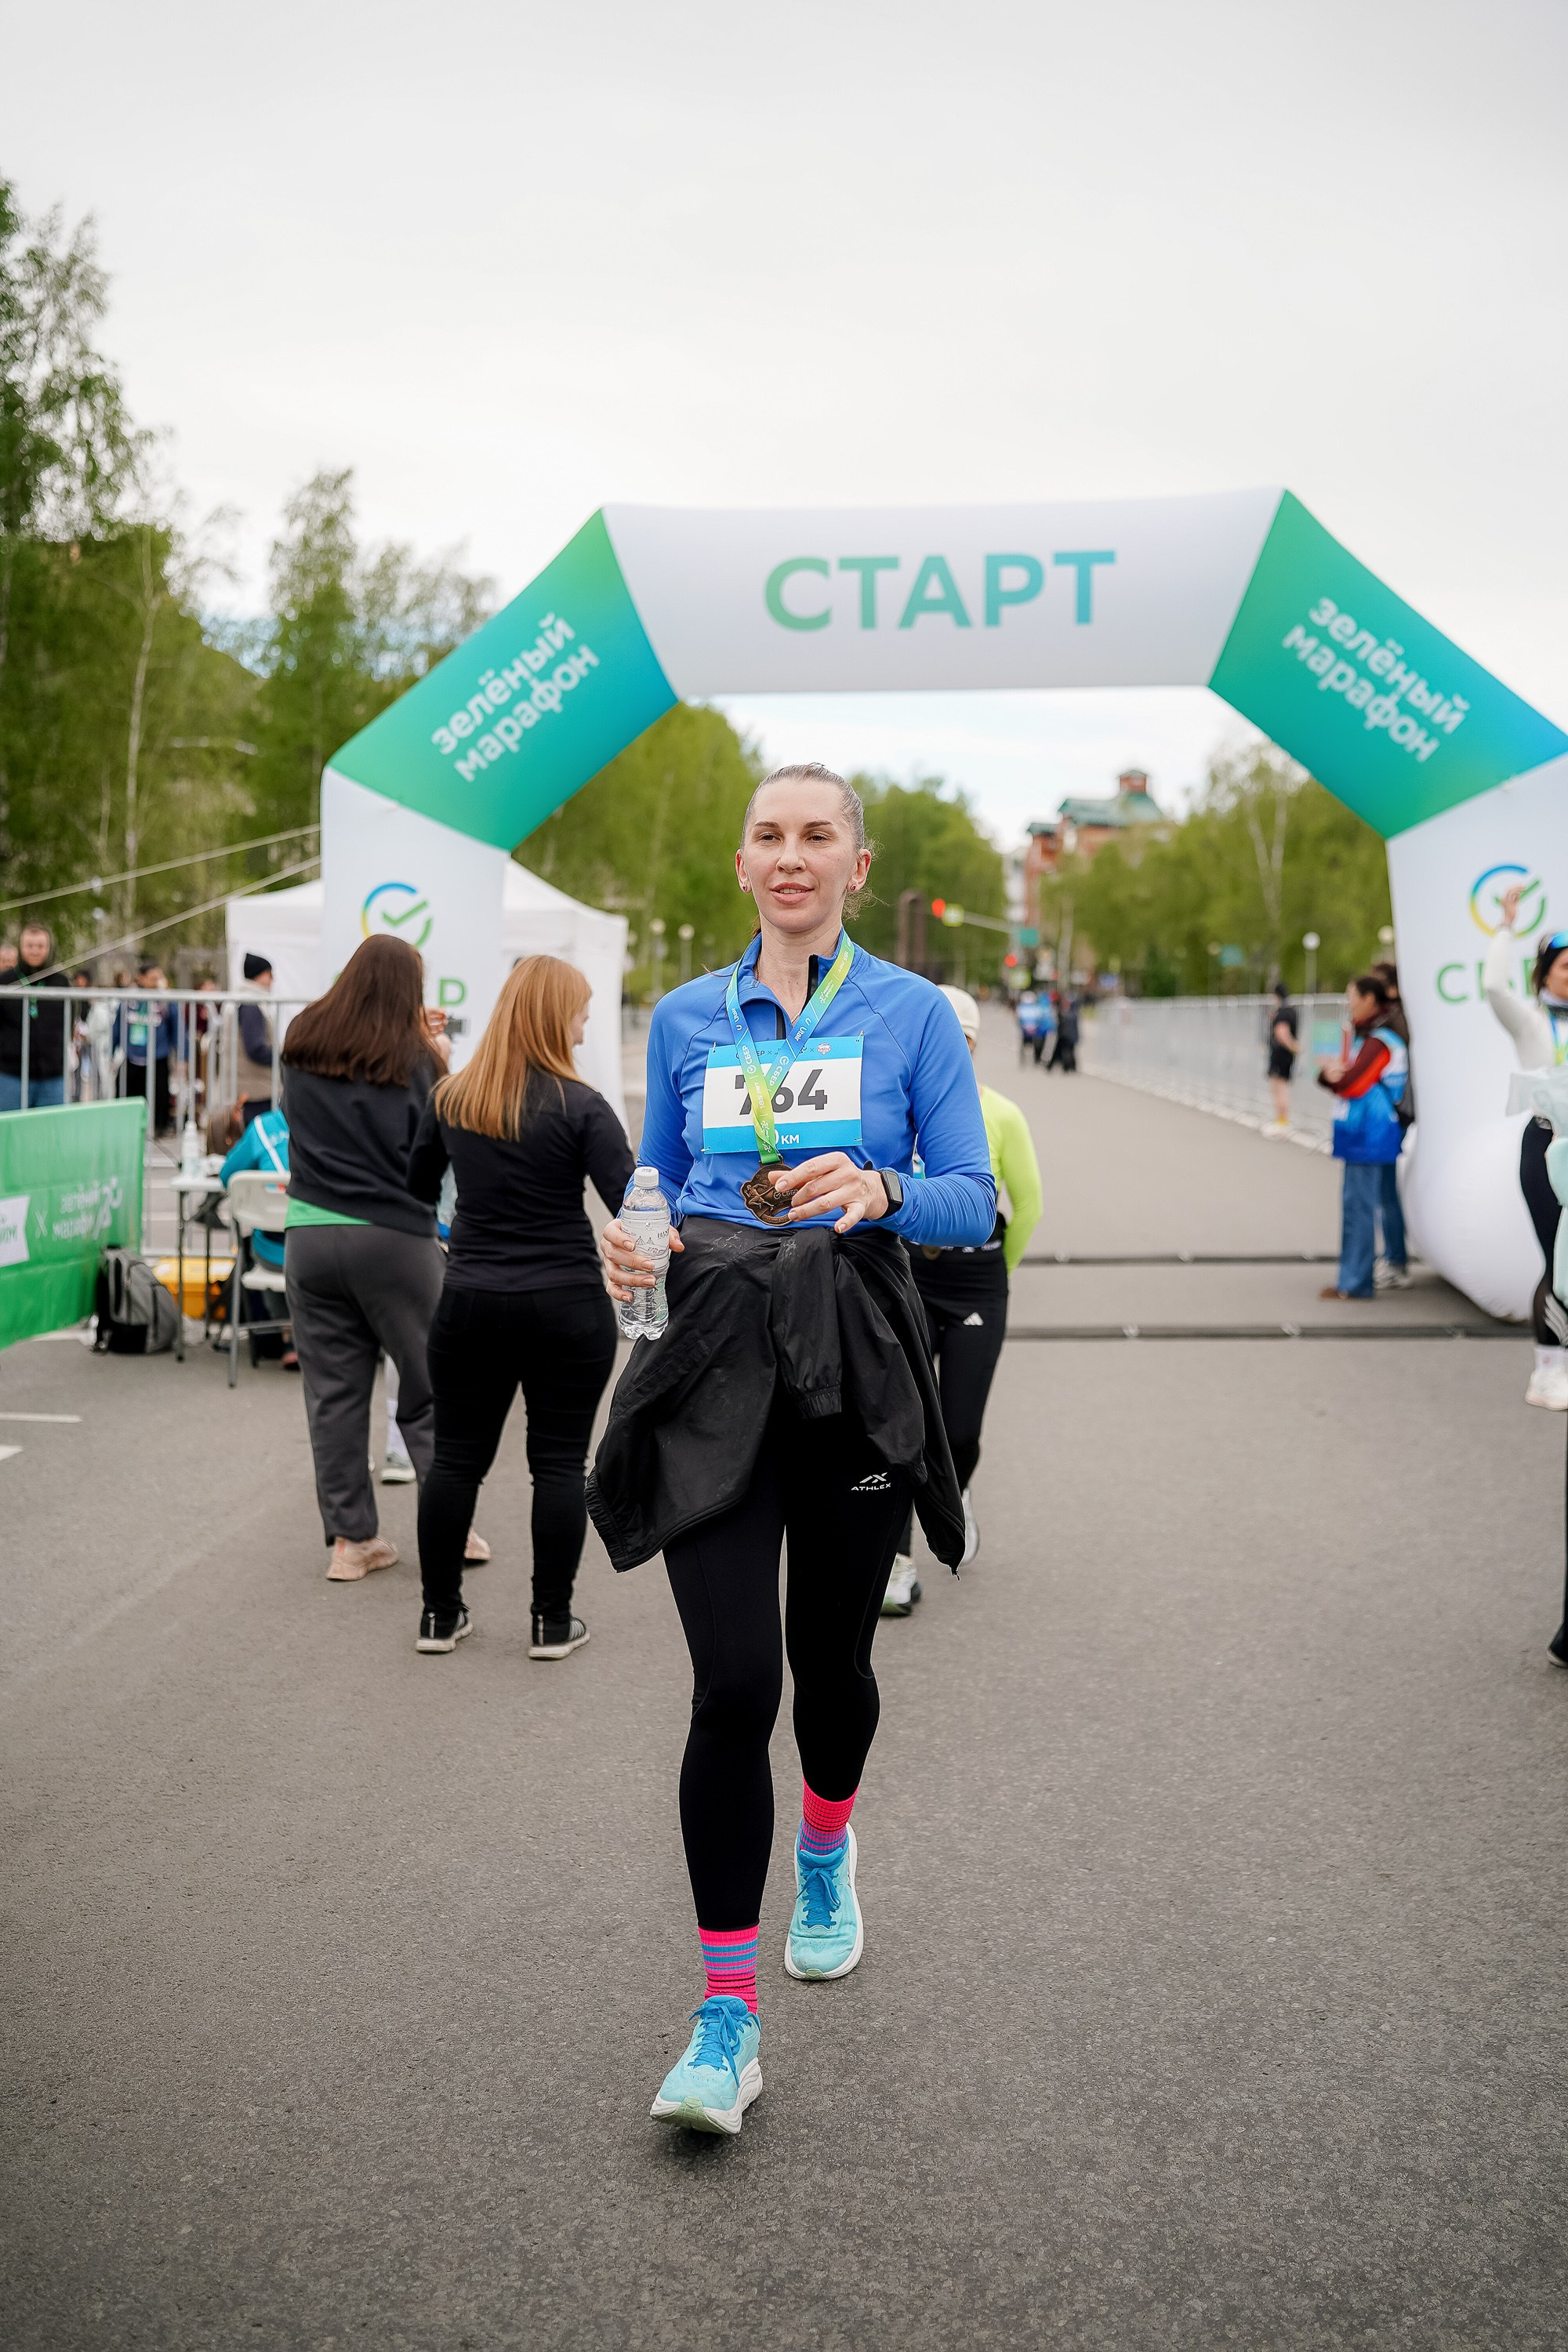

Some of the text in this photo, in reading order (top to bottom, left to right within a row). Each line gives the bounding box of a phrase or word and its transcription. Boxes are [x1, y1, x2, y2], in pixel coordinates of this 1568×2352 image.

[764, 550, 1116, 631] СТАРТ
[431, 612, 575, 755] зелёный
[1281, 624, 1440, 763] марафон
[1308, 597, 1470, 735] зелёный
[454, 644, 600, 782] марафон
[742, 1045, 753, 1064] СБЕР
[794, 1026, 808, 1042] Utair
[735, 1069, 828, 1116] 764
[769, 1065, 783, 1087] СБЕР
[851, 1483, 891, 1491] ATHLEX
